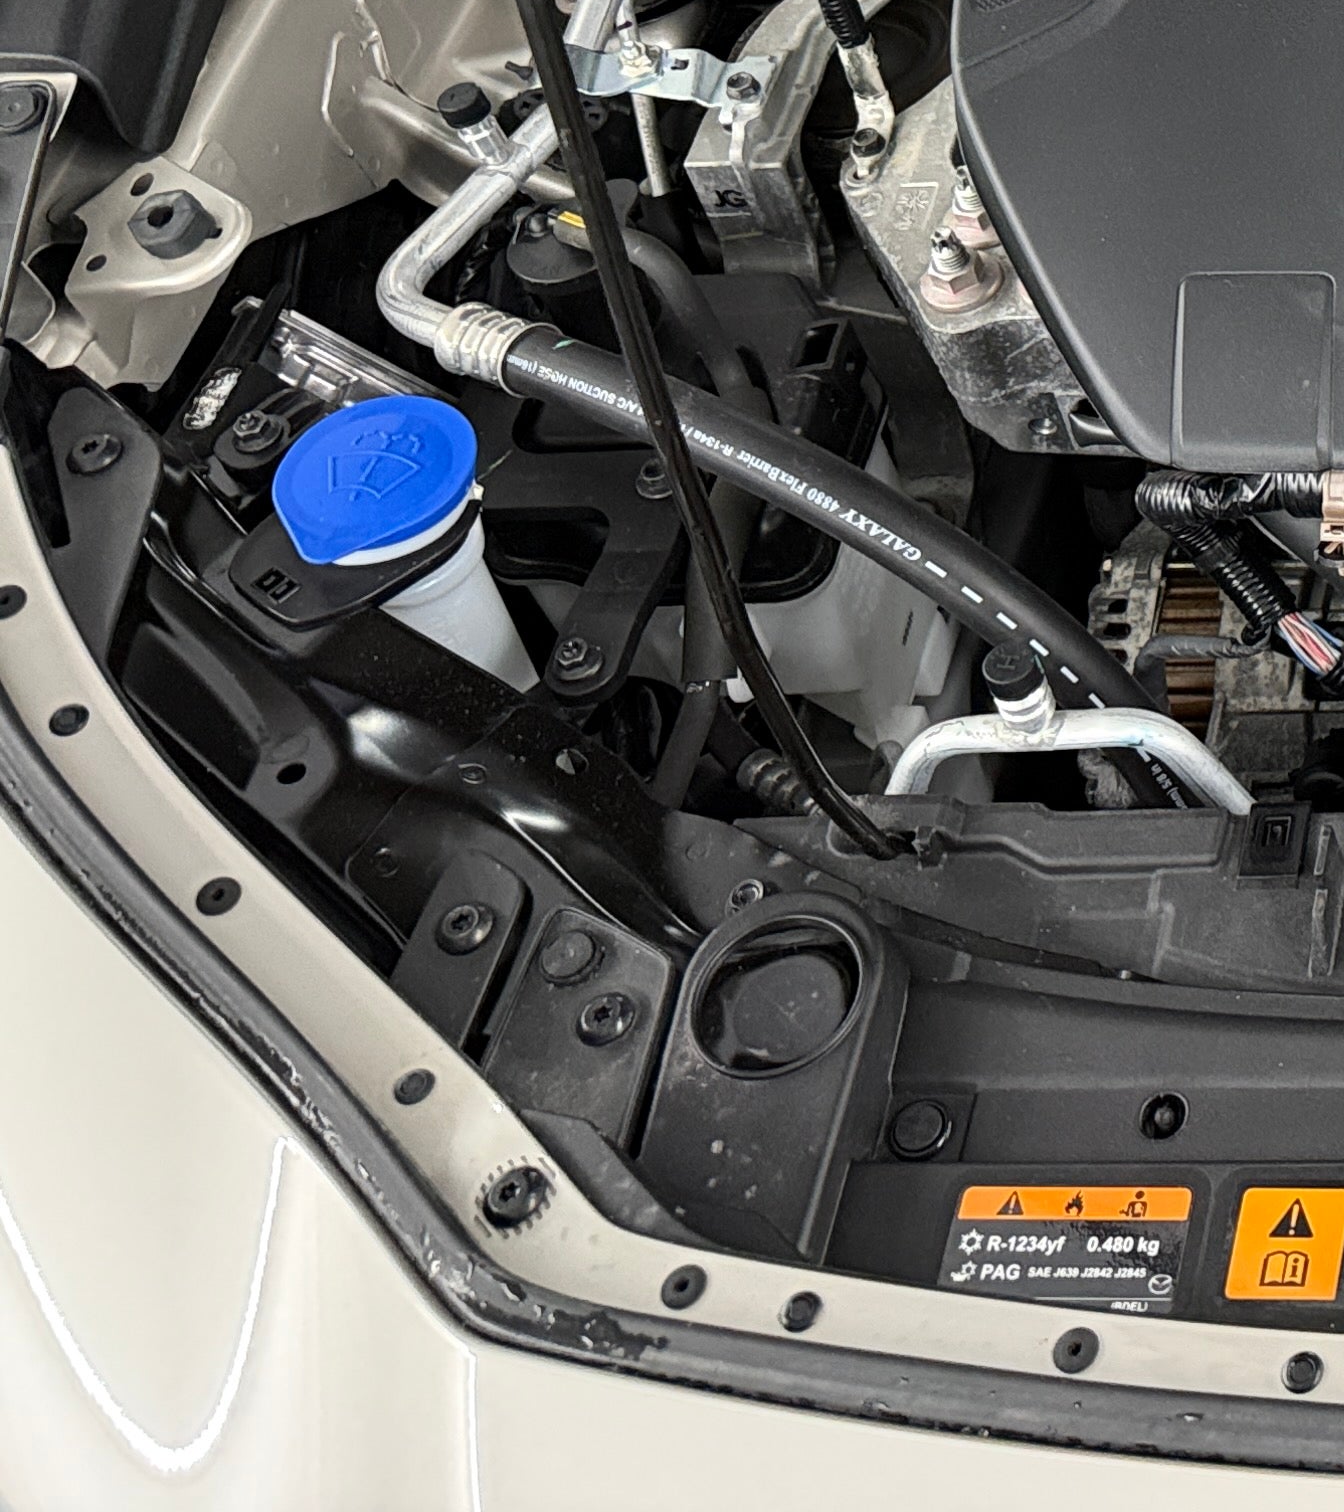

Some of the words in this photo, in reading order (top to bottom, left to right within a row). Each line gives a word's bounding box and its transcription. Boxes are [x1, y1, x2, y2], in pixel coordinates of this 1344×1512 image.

[714, 189, 748, 208] JG
[537, 365, 568, 387] HOSE
[567, 377, 617, 405] SUCTION
[692, 429, 734, 457] R-134a
[736, 450, 809, 495] FlexBarrier
[806, 486, 840, 513] 4880
[839, 507, 922, 562] GALAXY
[986, 1235, 1067, 1256] R-1234yf
[1086, 1236, 1135, 1253] 0.480
[1136, 1236, 1161, 1257] kg
[979, 1263, 1021, 1280] PAG
[1027, 1267, 1052, 1278] SAE
[1053, 1267, 1079, 1278] J639
[1080, 1267, 1113, 1278] J2842
[1113, 1267, 1147, 1278] J2845
